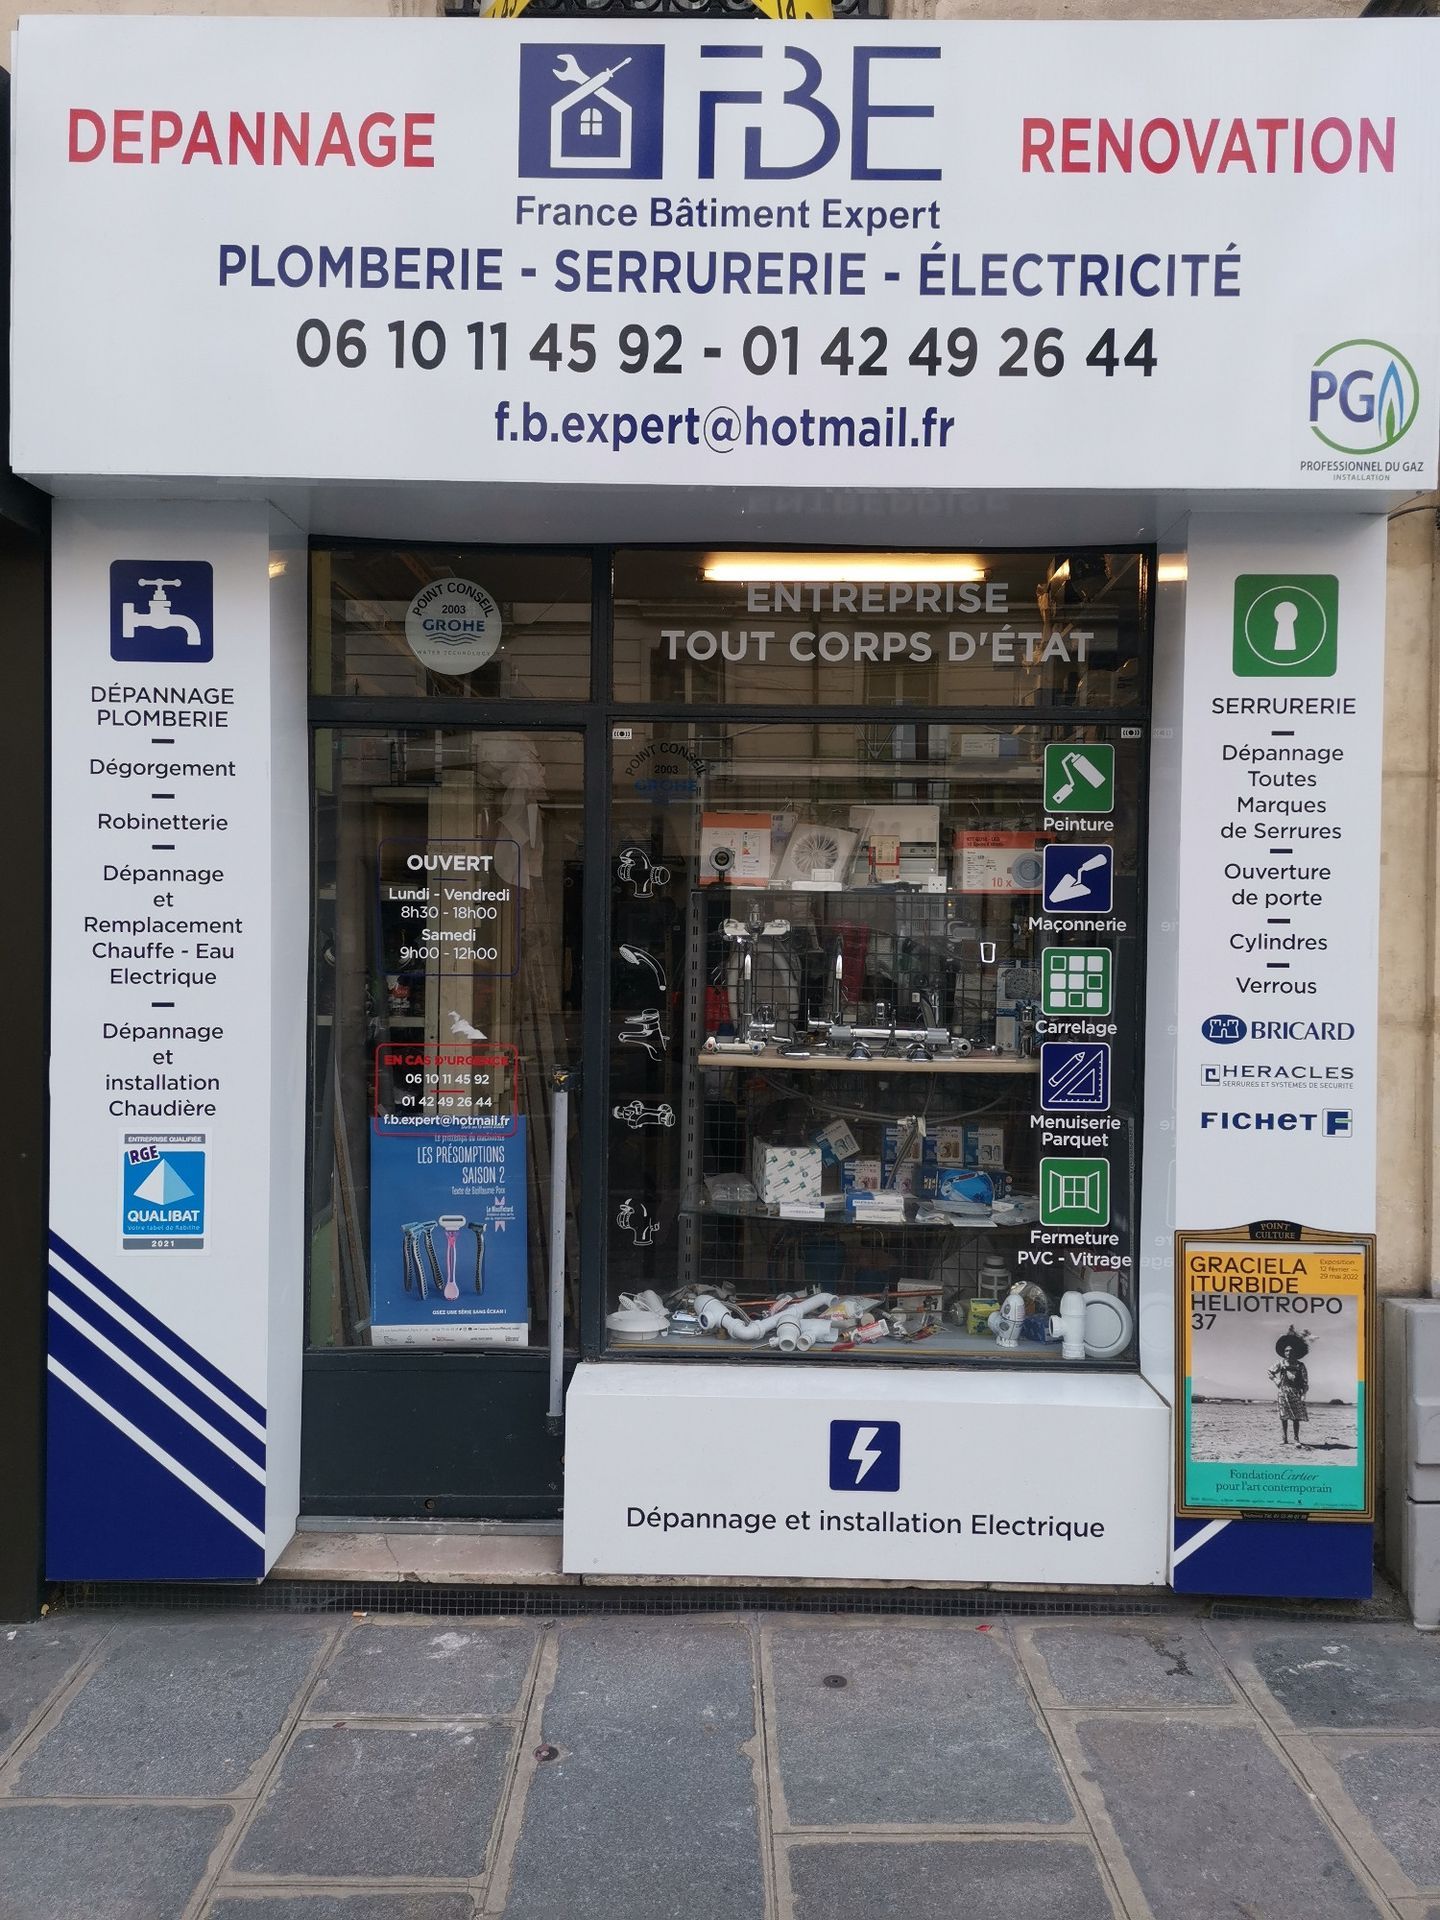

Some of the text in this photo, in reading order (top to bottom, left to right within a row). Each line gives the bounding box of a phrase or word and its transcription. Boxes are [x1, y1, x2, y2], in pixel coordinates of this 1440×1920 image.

[699, 45, 942, 181] FBE
[68, 108, 436, 169] DEPANNAGE
[1021, 116, 1396, 174] RENOVATION
[516, 196, 941, 235] France Bâtiment Expert
[218, 241, 1242, 297] PLOMBERIE SERRURERIE ÉLECTRICITÉ
[296, 318, 1158, 377] 06 10 11 45 92 01 42 49 26 44
[494, 401, 955, 454] f.b.expert@hotmail.fr
[1301, 461, 1424, 472] PROFESSIONNEL DU GAZ
[412, 582, 495, 618] POINT CONSEIL
[747, 582, 1009, 614] ENTREPRISE
[441, 604, 466, 615] 2003
[422, 618, 486, 632] GROHE
[661, 624, 1094, 663] TOUT CORPS D'ÉTAT
[91, 682, 235, 705] DÉPANNAGE
[1211, 697, 1356, 714] SERRURERIE
[97, 709, 229, 728] PLOMBERIE
[1222, 744, 1344, 765] Dépannage
[89, 758, 236, 779] Dégorgement
[654, 764, 679, 775] 2003
[1248, 771, 1317, 787] Toutes
[1237, 797, 1327, 816] Marques
[97, 813, 229, 831] Robinetterie
[1043, 817, 1115, 832] Peinture
[1220, 822, 1342, 839] de Serrures
[407, 854, 493, 872] OUVERT
[103, 865, 224, 884] Dépannage
[1224, 864, 1331, 880] Ouverture
[153, 894, 174, 907] et
[388, 887, 510, 902] Lundi Vendredi
[1231, 889, 1322, 908] de porte
[401, 906, 498, 920] 8h30 18h00
[84, 917, 243, 936] Remplacement
[1028, 917, 1127, 933] Maçonnerie
[422, 928, 477, 942] Samedi
[1230, 934, 1328, 952] Cylindres
[92, 942, 234, 959] Chauffe Eau
[400, 947, 498, 960] 9h00 12h00
[110, 969, 217, 987] Electrique
[1236, 977, 1317, 994] Verrous
[103, 1023, 224, 1042] Dépannage
[1035, 1020, 1117, 1037] Carrelage
[1251, 1021, 1355, 1041] BRICARD
[152, 1050, 174, 1065] et
[384, 1056, 403, 1066] EN
[406, 1056, 431, 1066] CAS
[405, 1074, 490, 1085] 06 10 11 45 92
[1223, 1065, 1354, 1080] HERACLES
[105, 1074, 220, 1091] installation
[1222, 1080, 1260, 1088] SERRURES
[1271, 1081, 1307, 1089] SYSTEMES
[108, 1100, 217, 1117] Chaudière
[402, 1097, 492, 1107] 01 42 49 26 44
[383, 1114, 510, 1127] f.b.expert@hotmail.fr
[1030, 1115, 1121, 1130] Menuiserie
[1042, 1132, 1108, 1148] Parquet
[130, 1145, 159, 1164] RGE
[417, 1143, 505, 1163] LES PRÉSOMPTIONS
[462, 1166, 505, 1183] SAISON 2
[127, 1210, 201, 1223] QUALIBAT
[1261, 1222, 1290, 1231] POINT
[1030, 1230, 1119, 1246] Fermeture
[1255, 1231, 1296, 1240] CULTURE
[1017, 1251, 1053, 1265] PVC
[1070, 1251, 1132, 1268] Vitrage
[1190, 1256, 1307, 1275] GRACIELA
[1191, 1275, 1298, 1294] ITURBIDE
[1191, 1294, 1343, 1314] HELIOTROPO
[1191, 1313, 1217, 1330] 37
[1216, 1482, 1240, 1492] pour
[1262, 1484, 1332, 1496] contemporain
[626, 1506, 1105, 1541] Dépannage et installation Electrique
